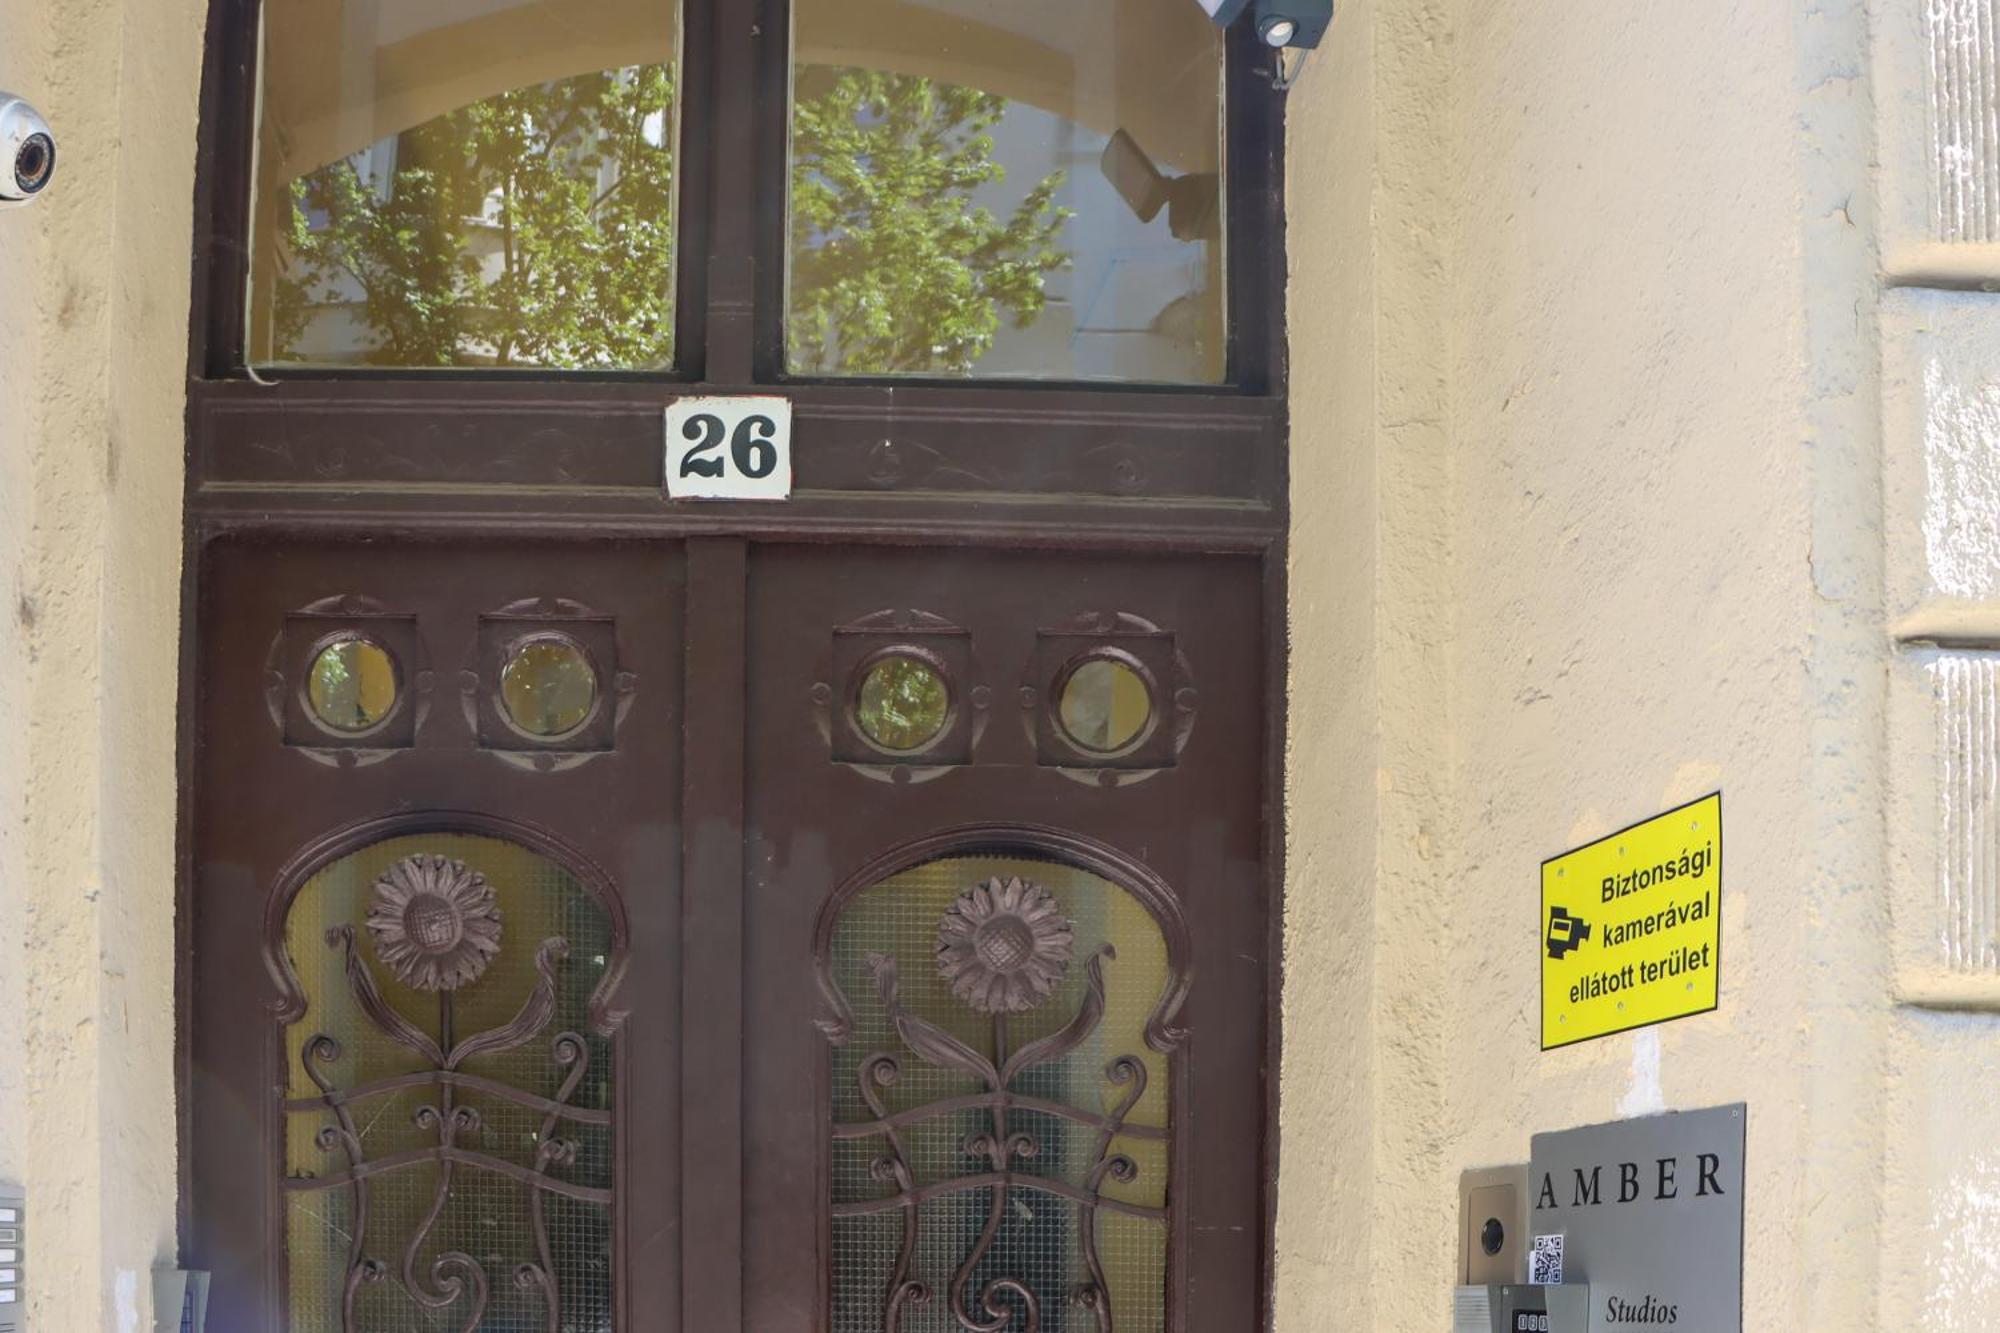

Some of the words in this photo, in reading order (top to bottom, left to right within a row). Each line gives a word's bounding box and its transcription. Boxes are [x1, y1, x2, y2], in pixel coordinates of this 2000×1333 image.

[680, 413, 777, 479] 26
[1601, 841, 1712, 903] Biztonsági
[1603, 890, 1710, 948] kamerával
[1570, 964, 1634, 1003] ellátott
[1639, 942, 1709, 984] terület
[1536, 1153, 1725, 1209] AMBER
[1606, 1294, 1677, 1324] Studios
